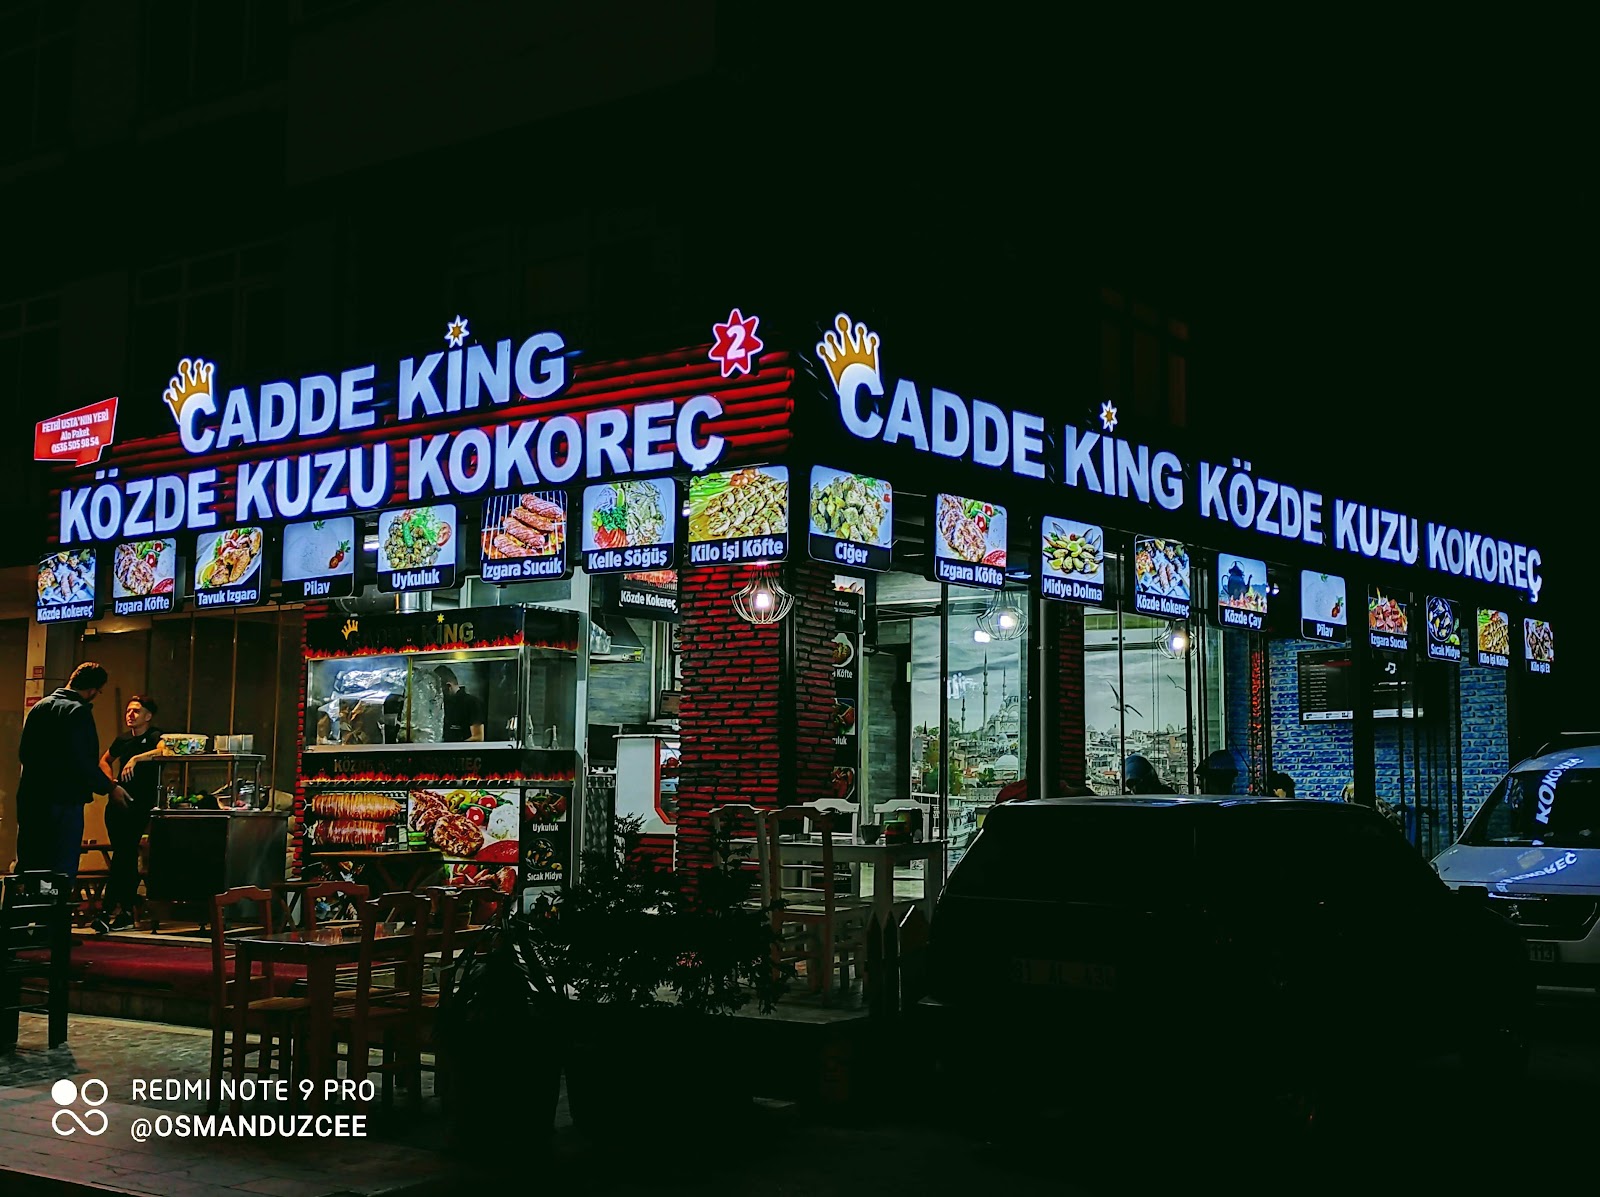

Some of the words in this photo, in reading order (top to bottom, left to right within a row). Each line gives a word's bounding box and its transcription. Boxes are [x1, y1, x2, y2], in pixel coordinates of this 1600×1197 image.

[726, 325, 746, 360] 2
[180, 365, 375, 453] CADDE
[72, 427, 90, 439] Paket
[60, 468, 216, 543] KÖZDE
[236, 442, 387, 522] KUZU
[408, 395, 725, 500] KOKOREÇ
[839, 362, 1045, 479] CADDE
[1200, 457, 1323, 545] KÖZDE
[1336, 499, 1419, 565] KUZU
[1427, 522, 1542, 603] KOKOREÇ
[588, 550, 621, 570] Kelle
[624, 547, 667, 568] Söğüş
[691, 542, 720, 562] Kilo
[722, 540, 740, 562] işi
[742, 537, 783, 558] Köfte
[835, 541, 868, 564] Ciğer
[391, 569, 440, 589] Uykuluk
[483, 563, 521, 580] Izgara
[939, 561, 973, 582] Izgara
[975, 566, 1003, 586] Köfte
[197, 591, 225, 605] Tavuk
[226, 590, 257, 603] Izgara
[304, 580, 330, 596] Pilav
[1043, 577, 1071, 597] Midye
[1072, 583, 1103, 602] Dolma
[115, 599, 142, 614] Izgara
[144, 596, 169, 610] Köfte
[621, 590, 645, 605] Közde
[646, 594, 678, 611] Kokereç
[1137, 593, 1160, 610] Közde
[1160, 597, 1190, 618] Kokereç
[37, 608, 60, 621] Közde
[61, 603, 93, 618] Kokereç
[1224, 608, 1247, 624] Közde
[1248, 613, 1262, 630] Çay
[1316, 623, 1334, 638] Pilav
[1370, 633, 1389, 648] Izgara
[837, 668, 853, 678] Köfte
[532, 823, 559, 833] Uykuluk
[544, 871, 562, 880] Midye
